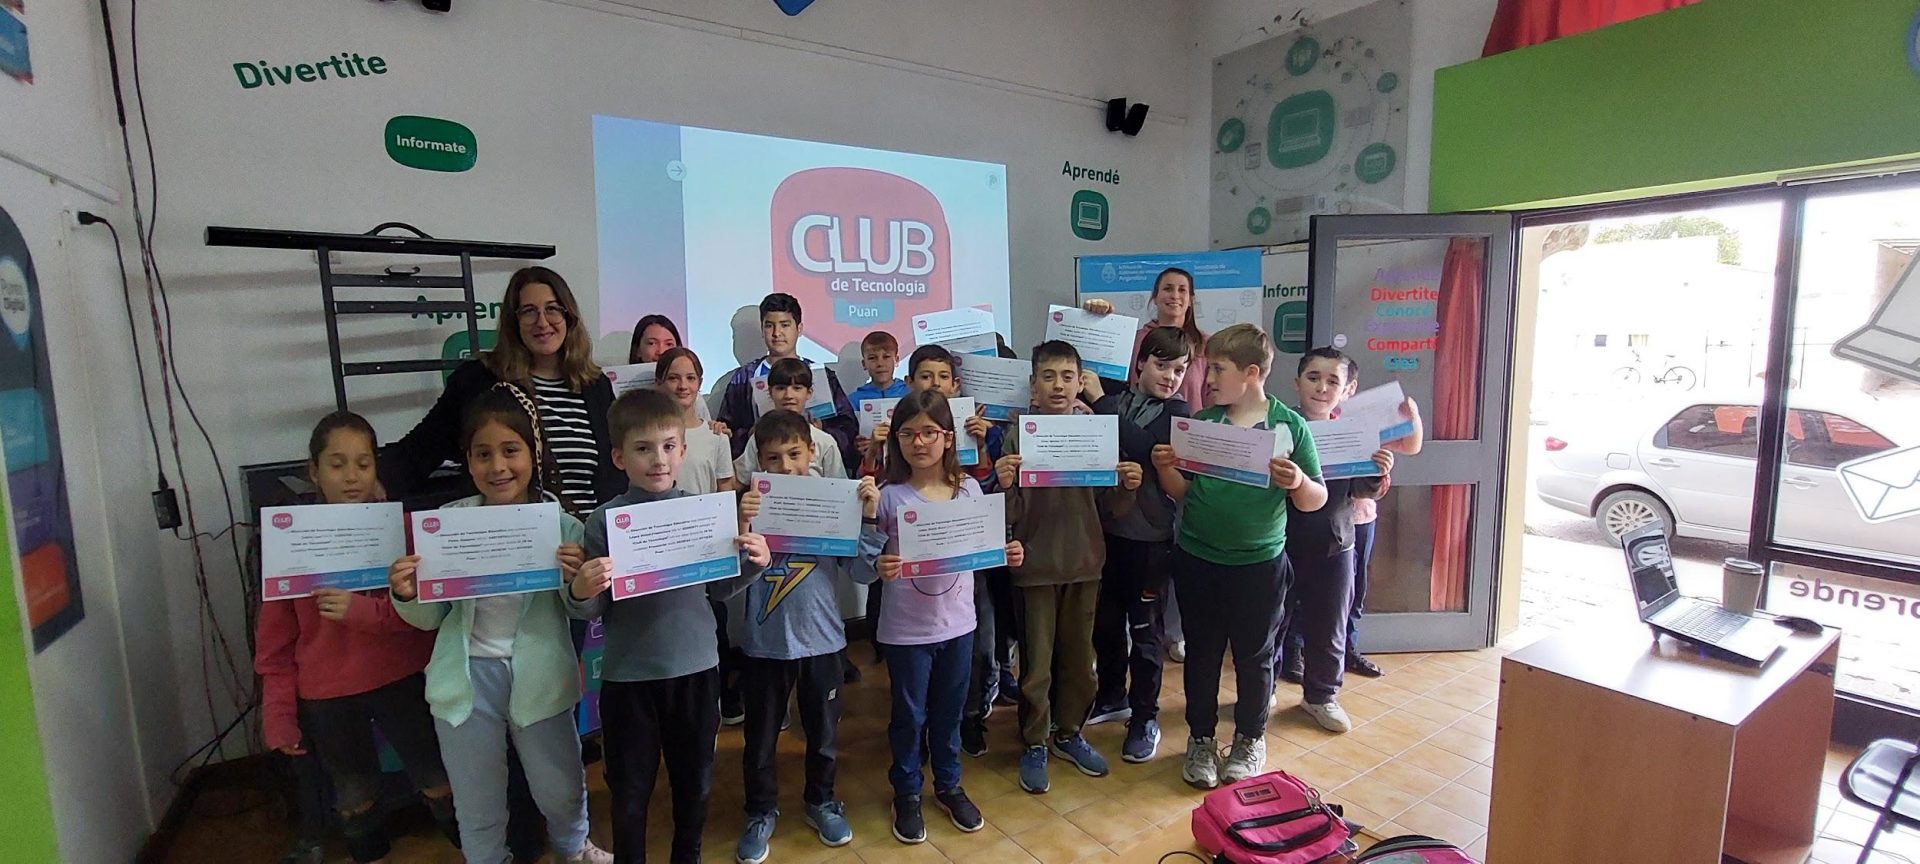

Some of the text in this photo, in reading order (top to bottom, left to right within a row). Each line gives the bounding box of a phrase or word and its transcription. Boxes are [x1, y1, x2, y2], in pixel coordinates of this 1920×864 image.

[233, 52, 388, 89] Divertite
[396, 134, 467, 154] Informate
[1062, 161, 1120, 184] Aprendé
[791, 214, 935, 276] CLUB
[831, 278, 926, 297] de Tecnología
[1370, 287, 1439, 301] Divertite
[848, 305, 879, 317] Puan
